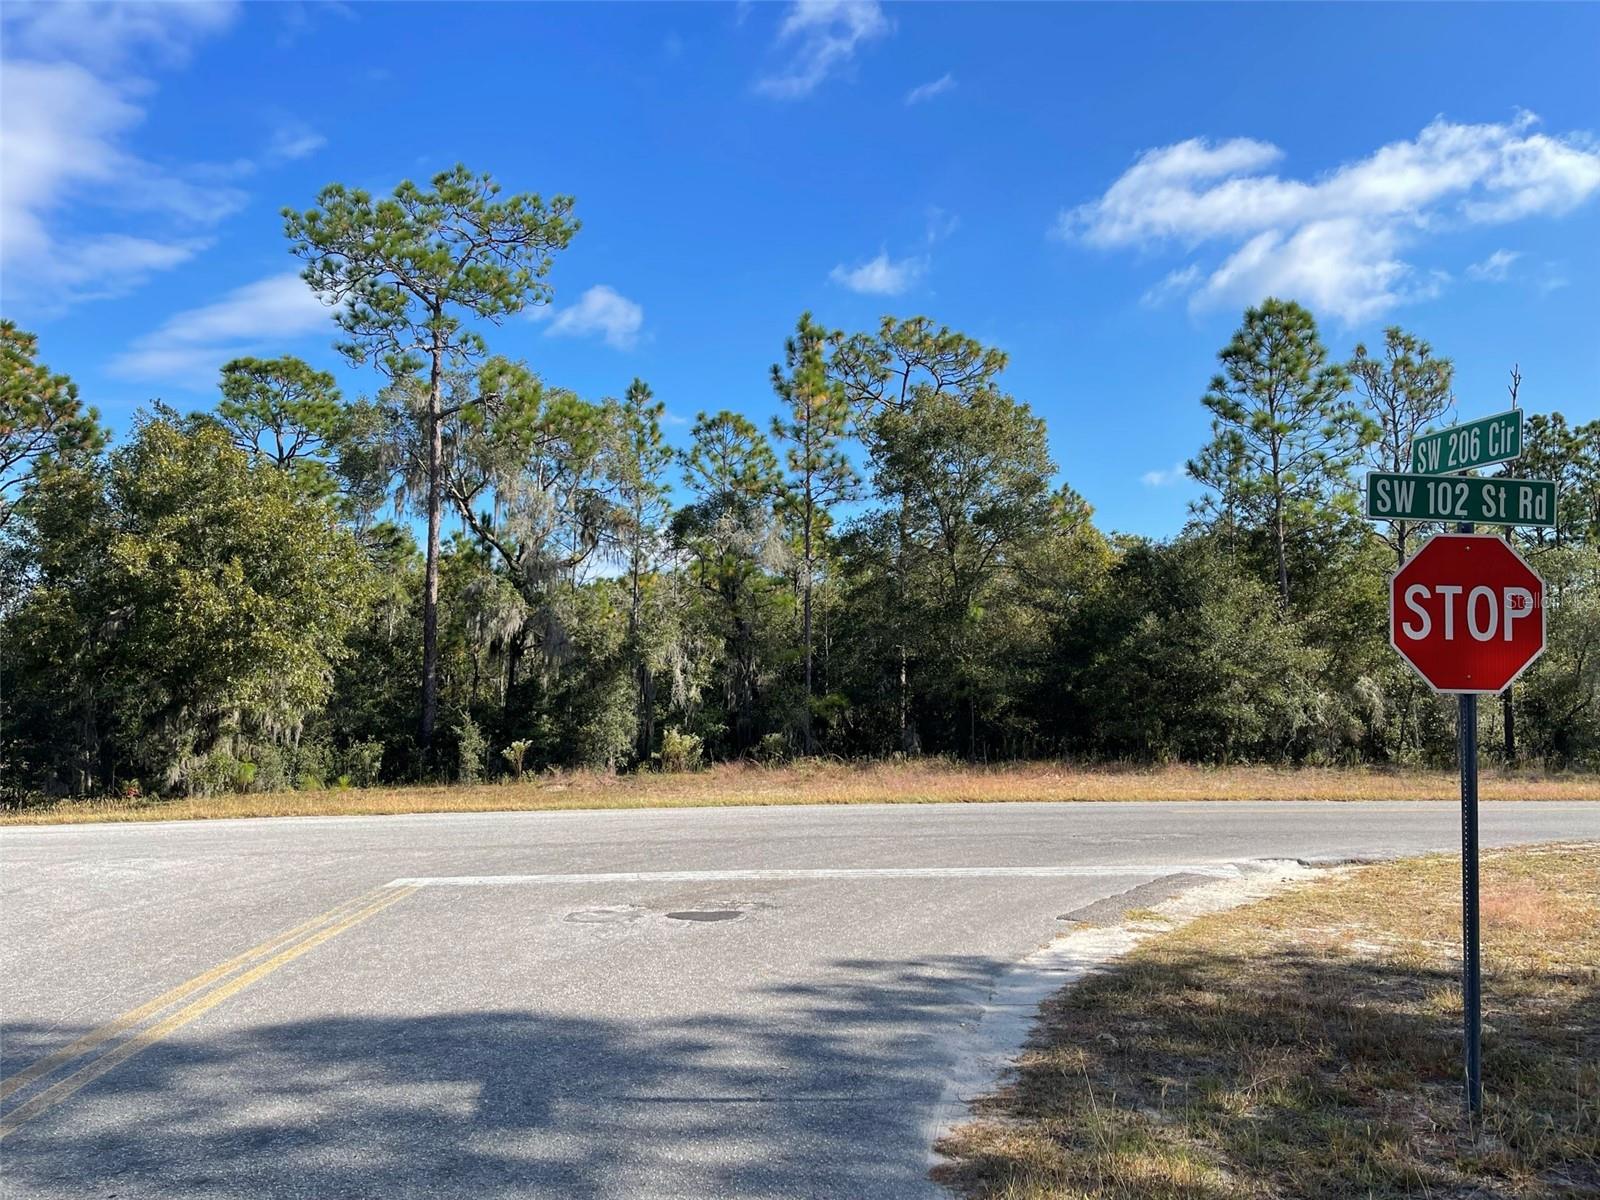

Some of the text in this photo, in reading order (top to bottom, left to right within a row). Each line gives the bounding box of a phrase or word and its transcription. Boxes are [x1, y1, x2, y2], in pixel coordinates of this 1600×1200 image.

[1417, 421, 1515, 473] SW 206 Cir
[1376, 479, 1547, 520] SW 102 St Rd
[1402, 584, 1533, 642] STOP
